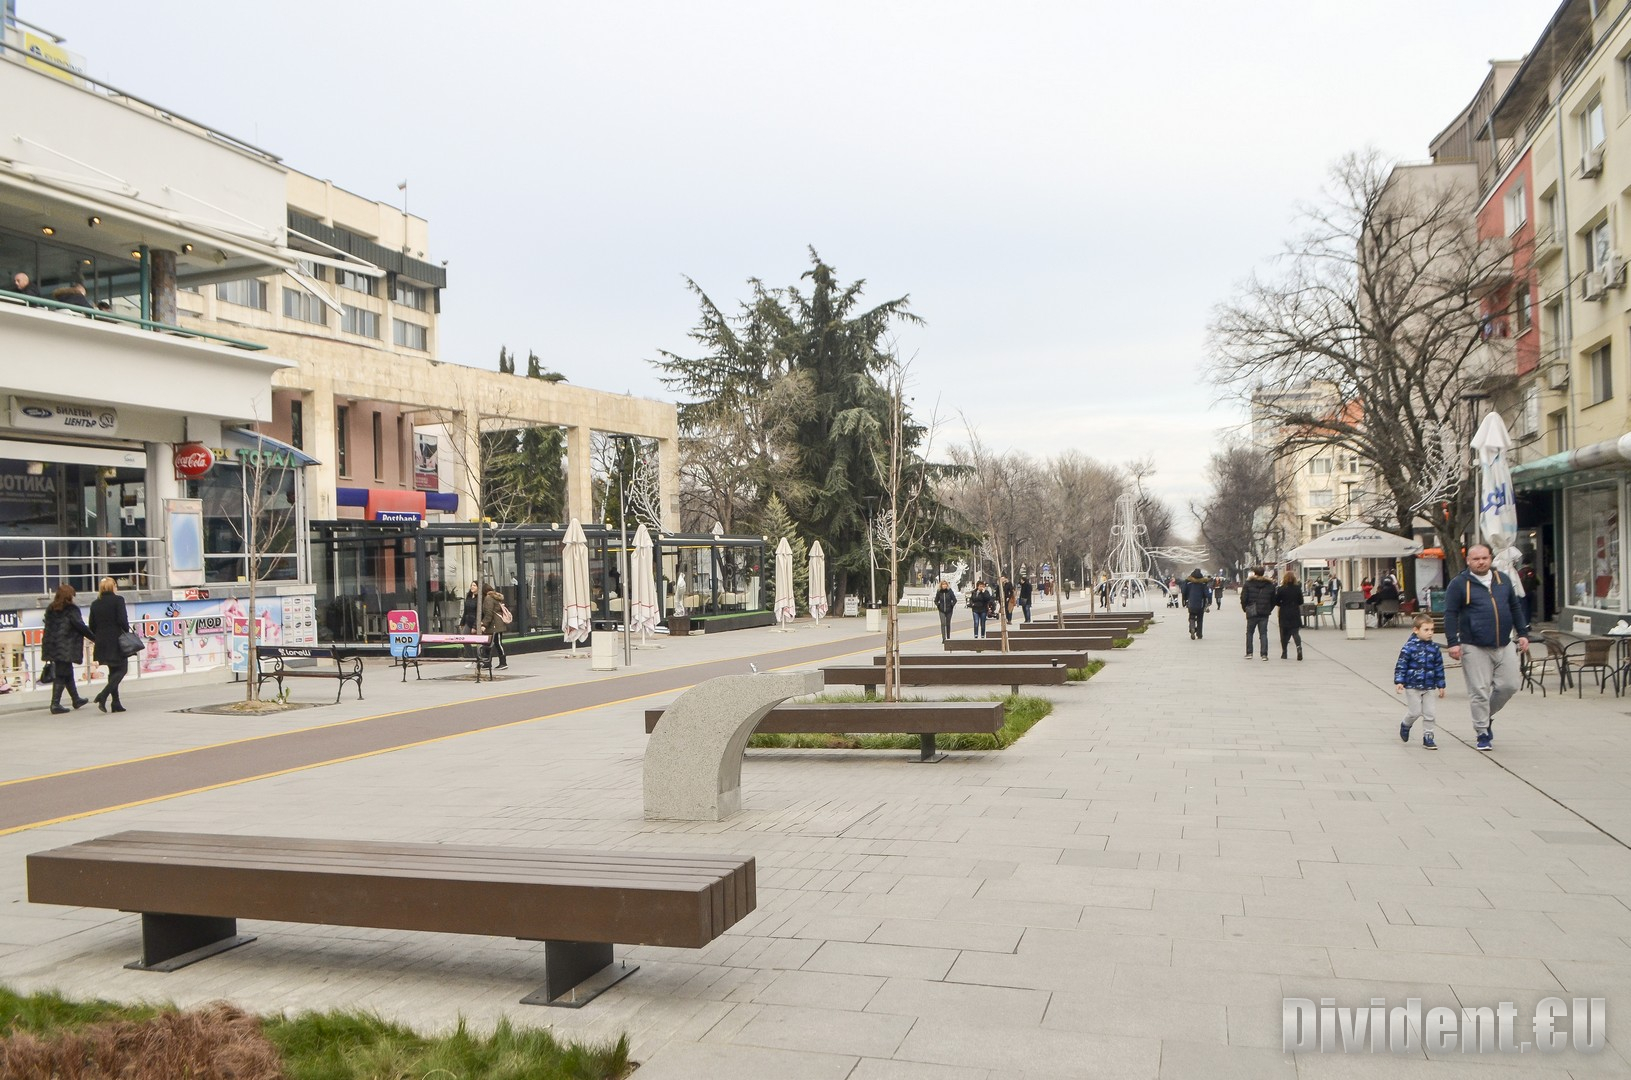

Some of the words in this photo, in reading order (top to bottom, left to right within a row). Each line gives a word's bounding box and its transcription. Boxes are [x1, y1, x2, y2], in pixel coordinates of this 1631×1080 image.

[56, 406, 92, 417] БИЛЕТЕН
[64, 417, 97, 428] ЦЕНТЪР
[389, 619, 416, 631] baby
[394, 636, 413, 644] MOD
